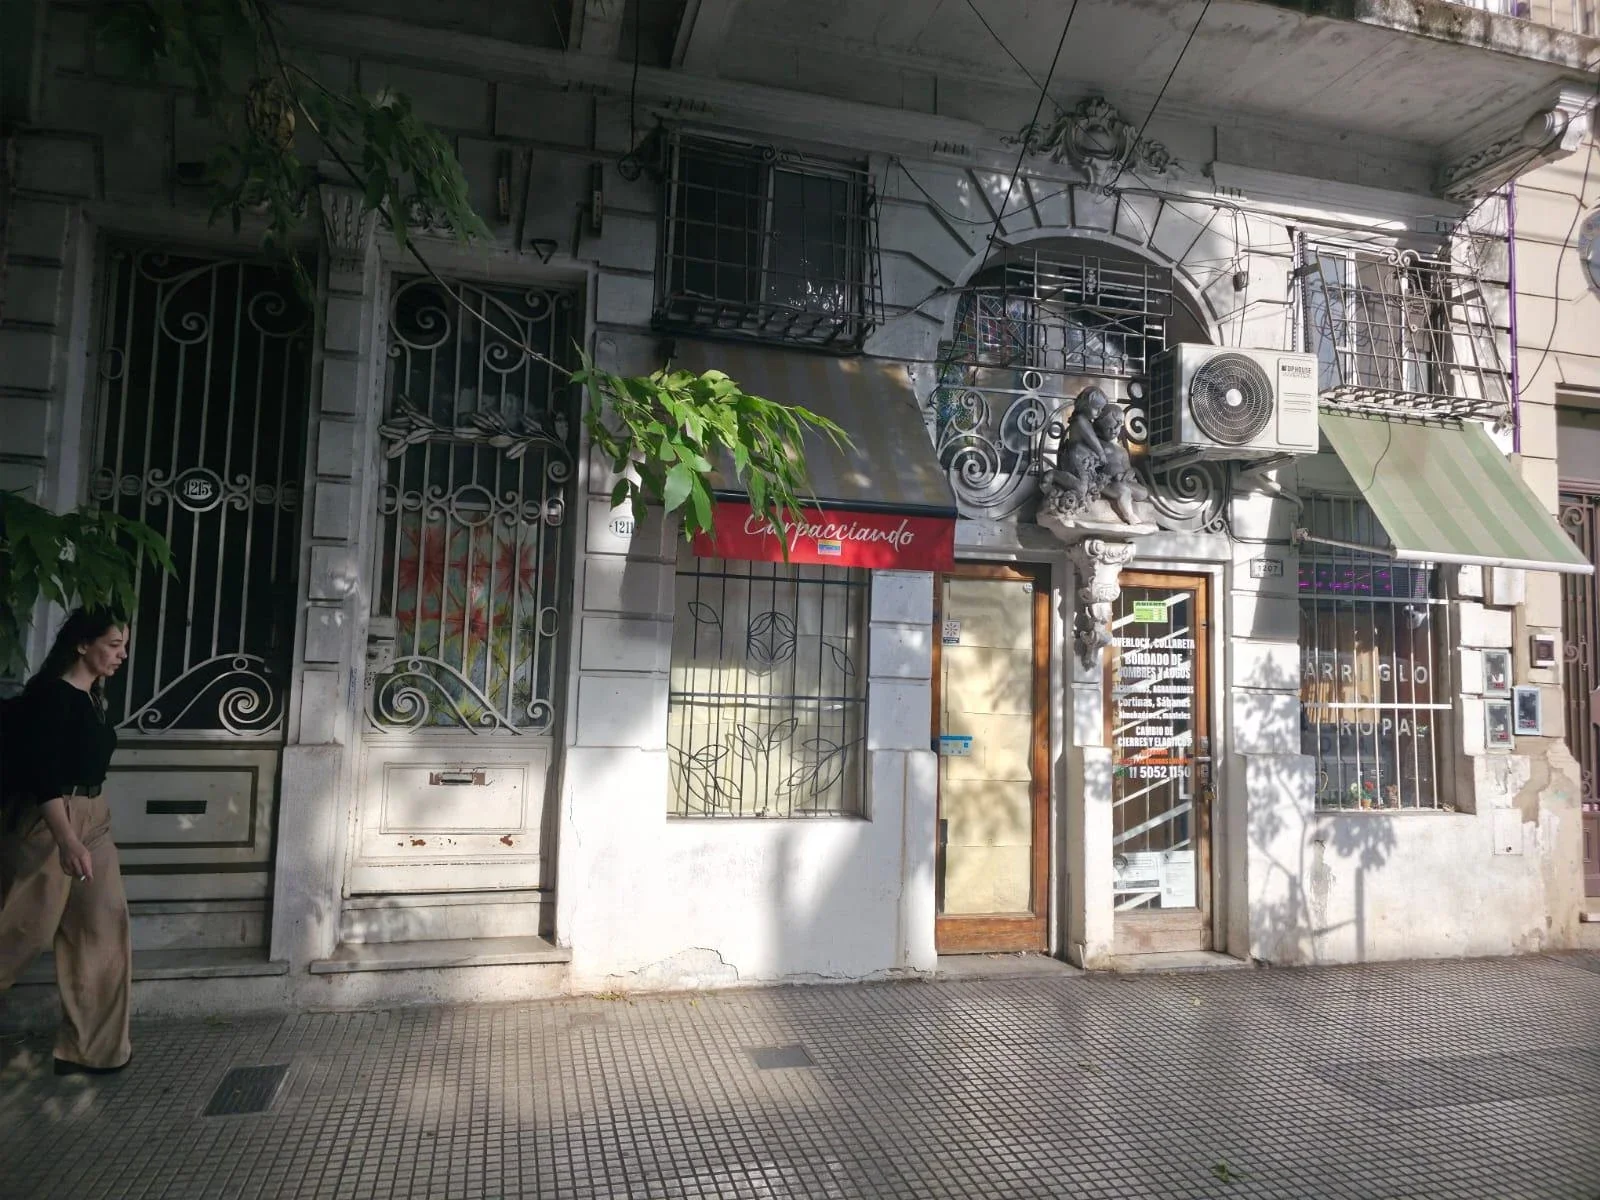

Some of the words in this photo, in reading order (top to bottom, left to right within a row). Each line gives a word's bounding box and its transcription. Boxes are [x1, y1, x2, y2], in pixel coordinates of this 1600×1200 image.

[186, 480, 209, 496] 1215
[1125, 652, 1169, 666] BORDADO
[1171, 653, 1183, 667] DE
[1136, 726, 1163, 736] CAMBIO
[1164, 726, 1174, 736] DE
[1118, 737, 1148, 747] CIERRES
[1140, 766, 1167, 778] 5052
